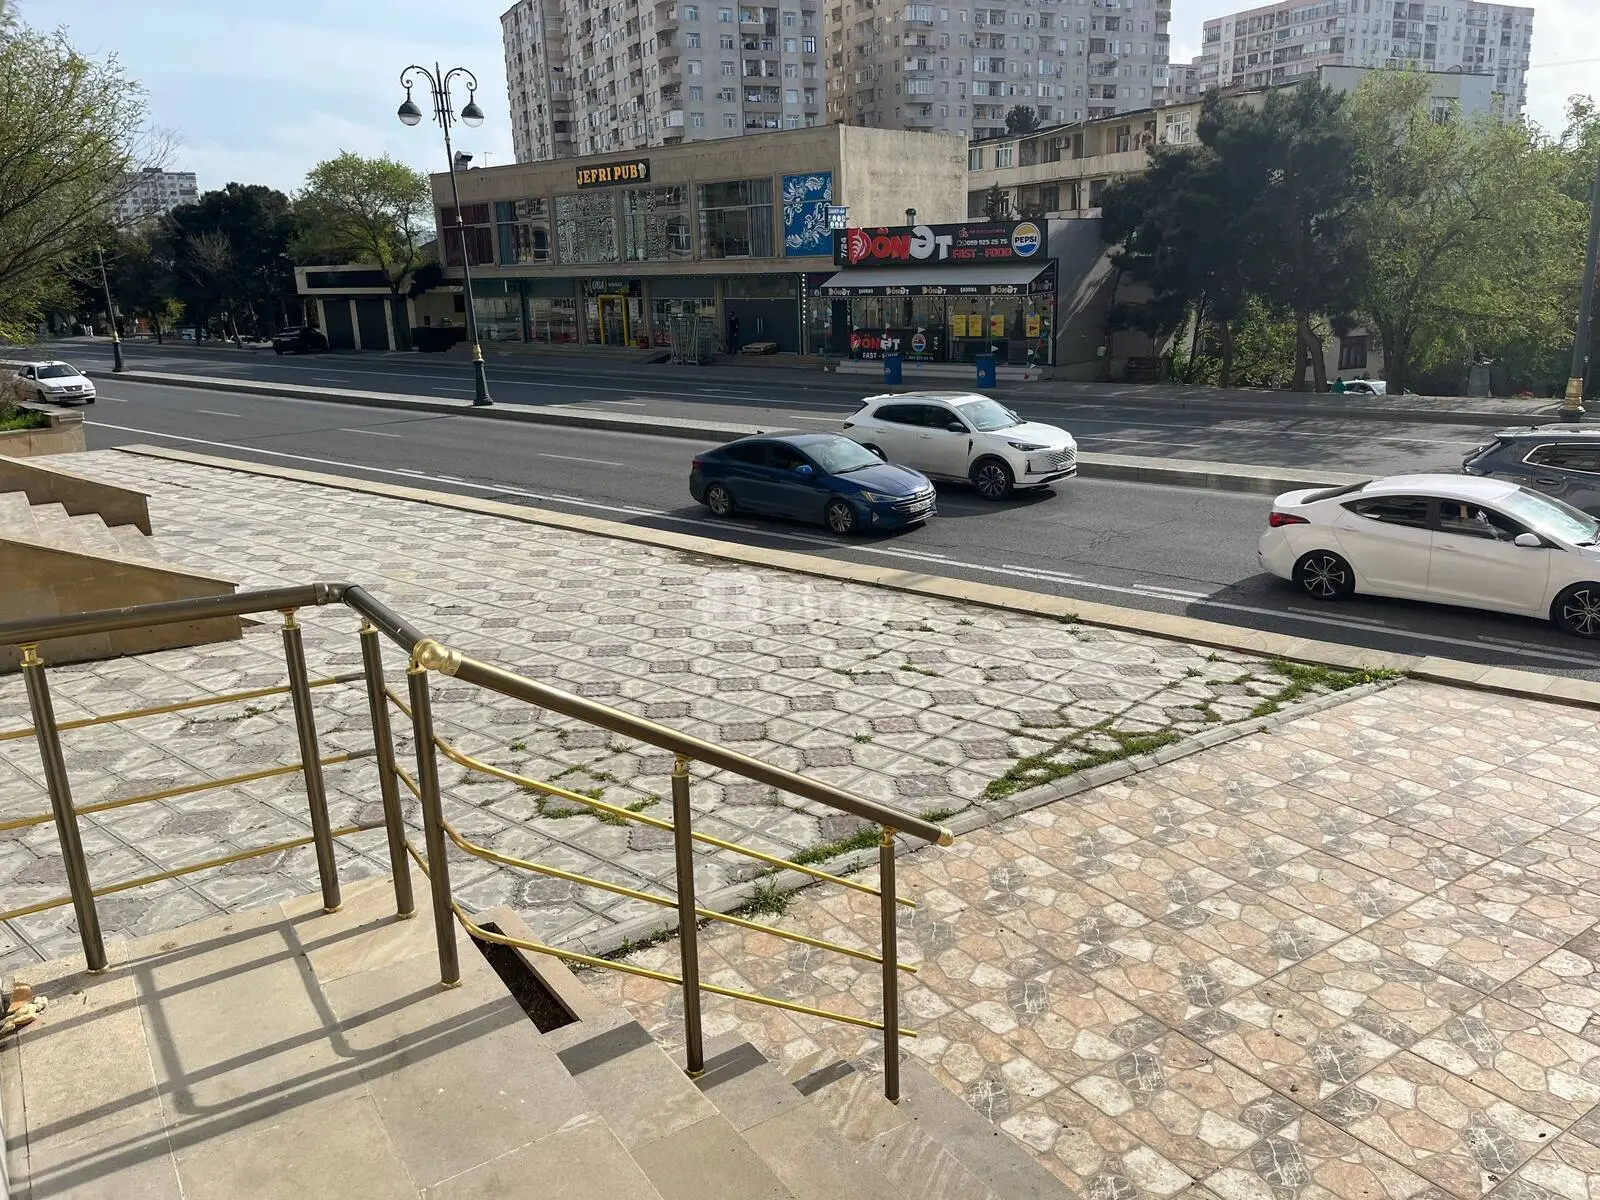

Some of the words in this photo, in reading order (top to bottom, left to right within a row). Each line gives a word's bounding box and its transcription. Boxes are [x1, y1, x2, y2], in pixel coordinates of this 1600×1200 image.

[577, 167, 612, 185] JEFRI
[614, 164, 638, 180] PUB
[1014, 235, 1037, 244] PEPSI
[840, 237, 848, 259] 7/24
[952, 248, 977, 259] FAST
[985, 247, 1013, 258] FOOD
